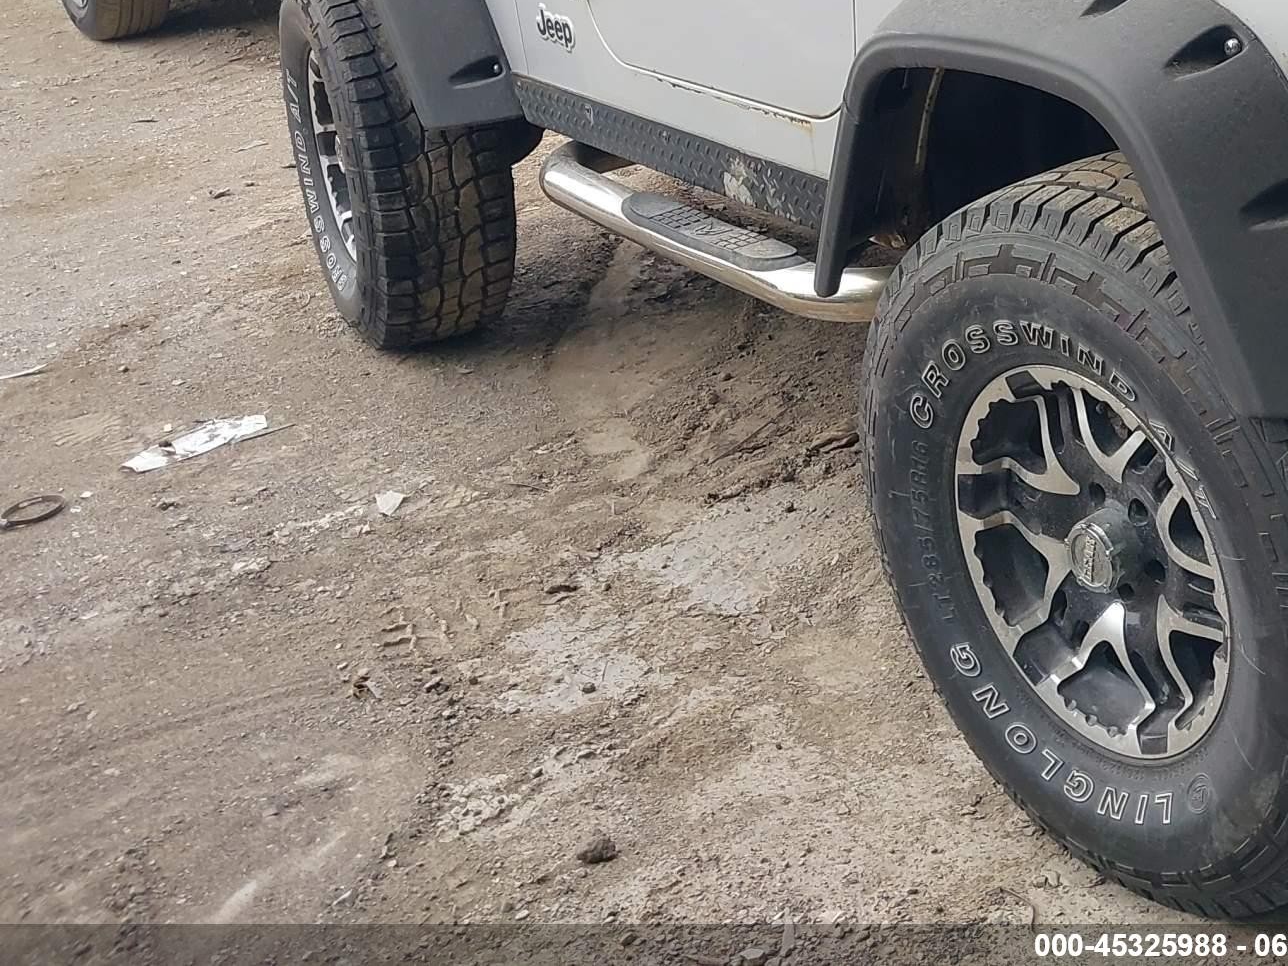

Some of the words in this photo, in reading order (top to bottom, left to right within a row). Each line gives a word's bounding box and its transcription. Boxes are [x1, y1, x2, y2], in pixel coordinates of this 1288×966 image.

[537, 8, 574, 49] Jeep
[285, 68, 302, 123] A/T
[294, 130, 349, 291] CROSSWIND
[909, 320, 1137, 428] CROSSWIND
[950, 642, 1173, 824] LINGLONG
